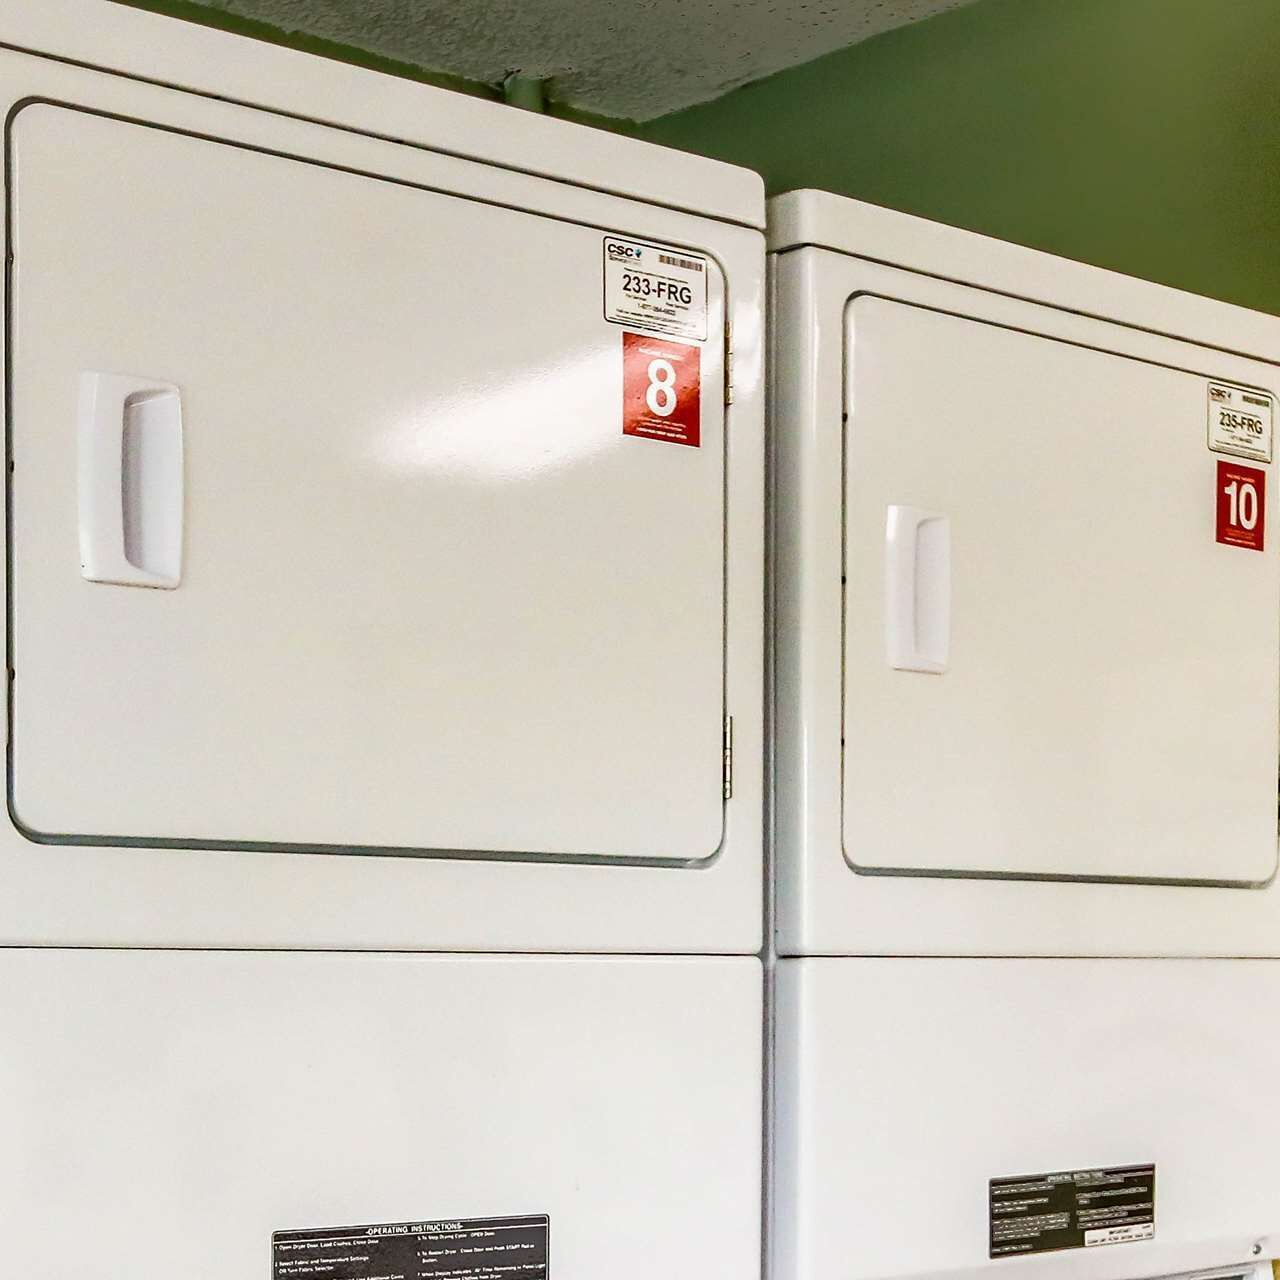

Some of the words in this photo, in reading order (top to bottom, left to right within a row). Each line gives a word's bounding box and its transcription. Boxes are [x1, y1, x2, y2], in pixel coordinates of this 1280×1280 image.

[607, 243, 634, 257] CSC
[622, 274, 691, 304] 233-FRG
[646, 358, 677, 417] 8
[1219, 412, 1263, 435] 235-FRG
[1224, 481, 1258, 530] 10
